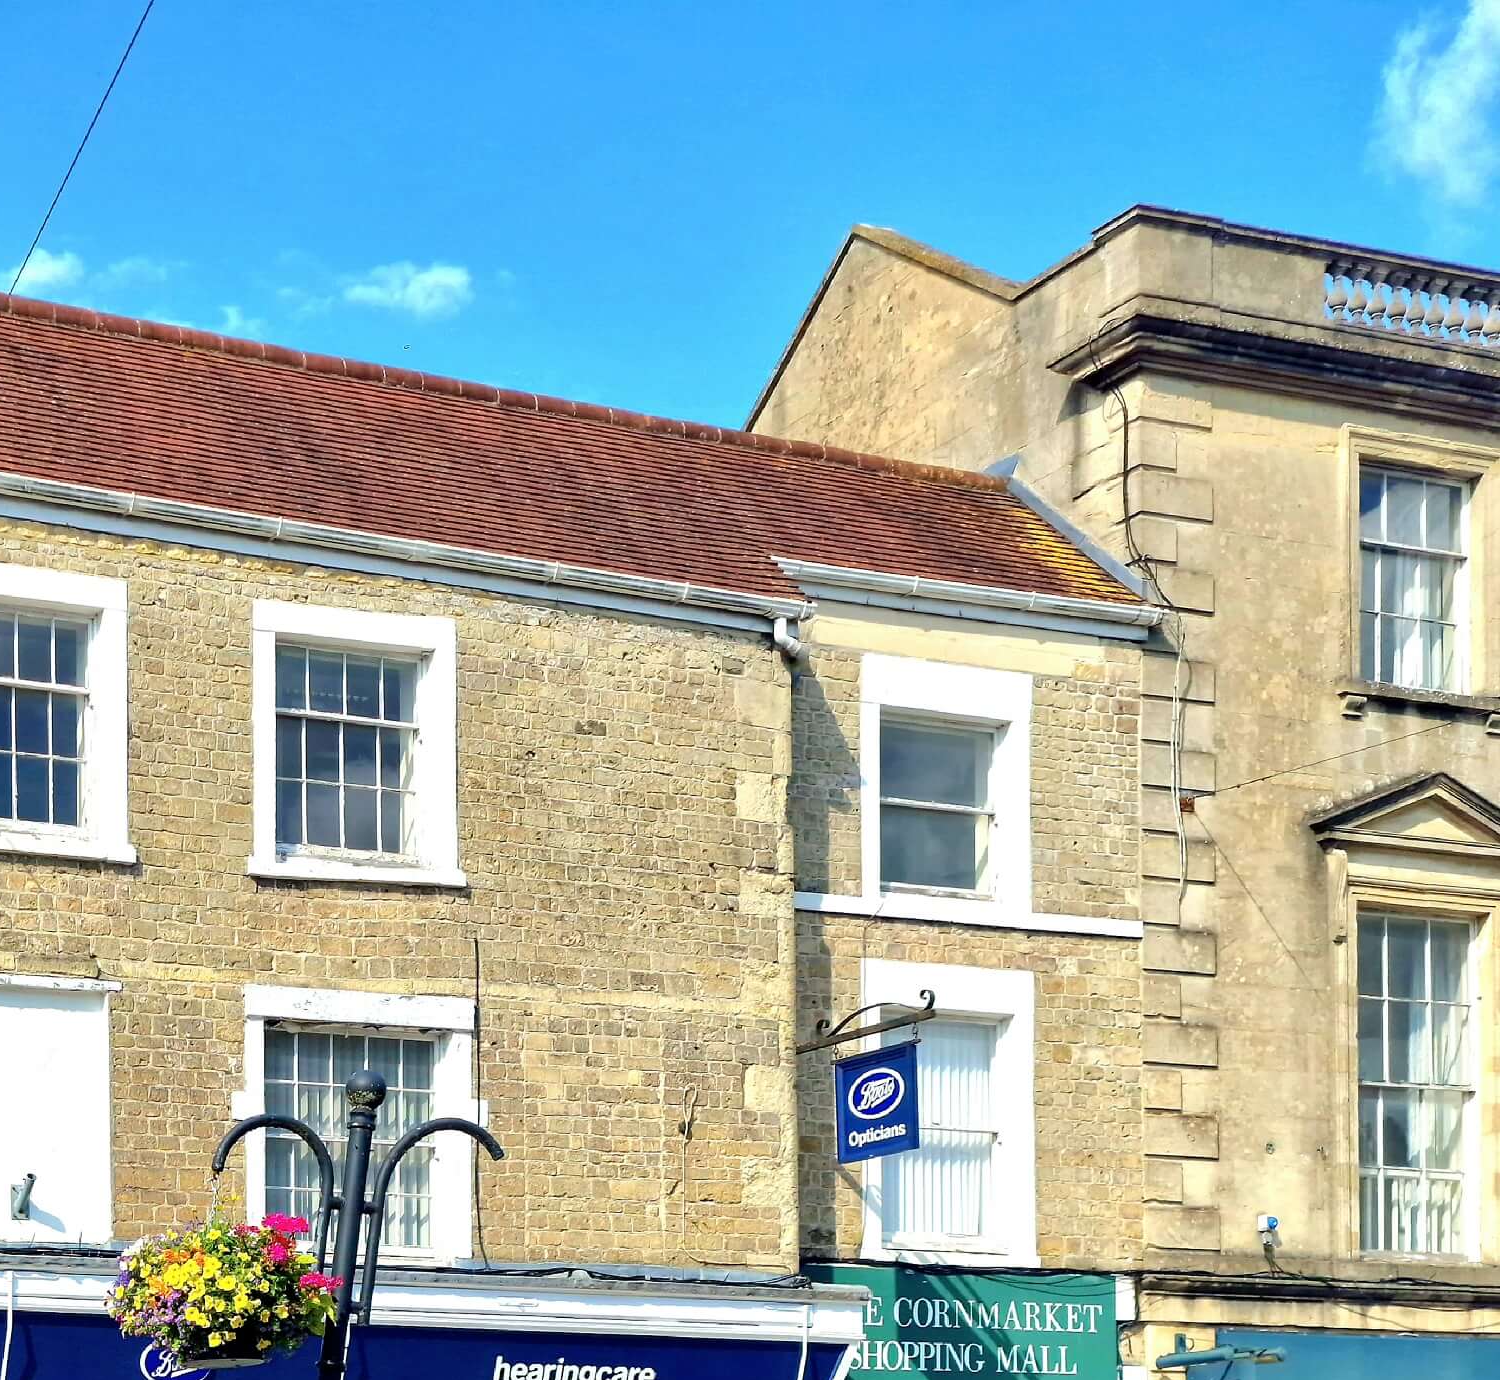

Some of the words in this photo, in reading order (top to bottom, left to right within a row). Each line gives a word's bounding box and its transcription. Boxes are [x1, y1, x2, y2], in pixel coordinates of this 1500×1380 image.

[848, 1123, 907, 1148] Opticians
[893, 1296, 1103, 1334] CORNMARKET
[996, 1344, 1078, 1376] MALL
